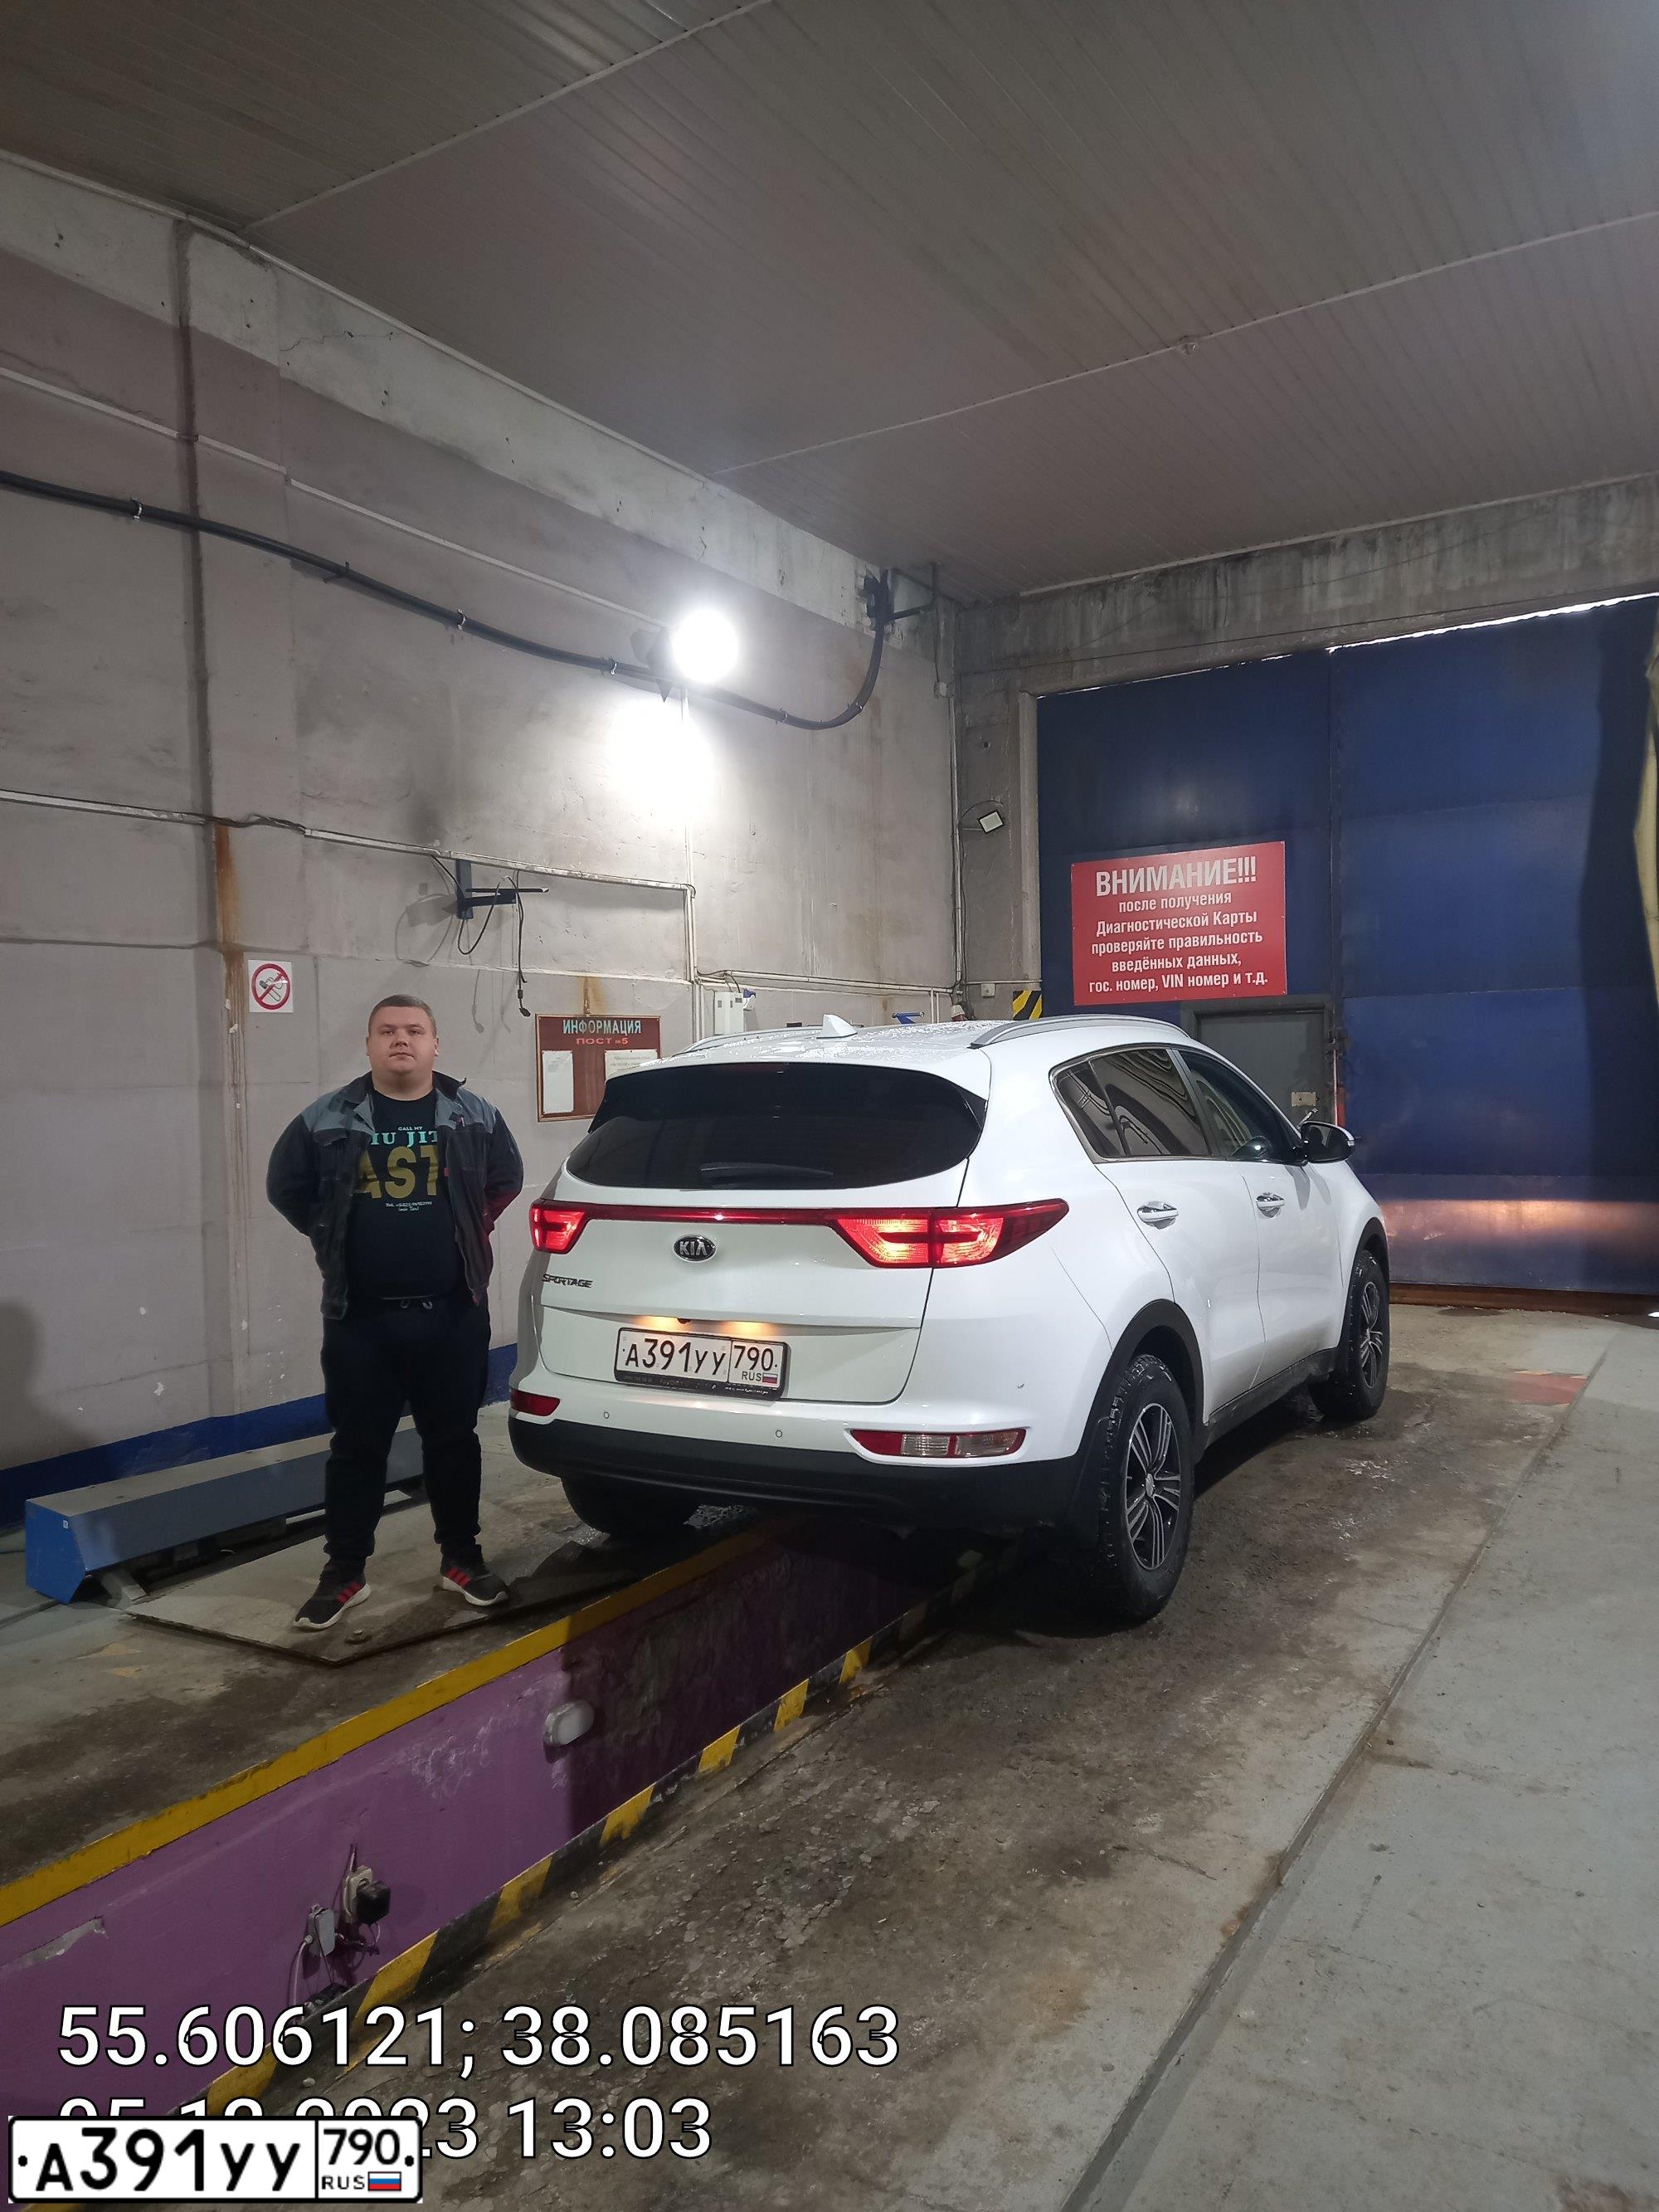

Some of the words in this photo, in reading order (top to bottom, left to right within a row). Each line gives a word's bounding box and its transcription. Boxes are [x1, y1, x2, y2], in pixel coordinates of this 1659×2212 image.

[1096, 856, 1257, 897] ВНИМАНИЕ!!!
[1119, 897, 1156, 913] после
[1160, 891, 1232, 910] получения
[1096, 913, 1209, 937] Диагностической
[1214, 909, 1258, 928] Карты
[1092, 935, 1164, 957] проверяйте
[1169, 931, 1262, 951] правильность
[1112, 954, 1183, 972] введённых
[1187, 952, 1241, 969] данных,
[1089, 980, 1112, 993] гос.
[1117, 977, 1159, 992] номер,
[1161, 973, 1184, 988] VIN
[1188, 970, 1229, 988] номер
[1233, 971, 1241, 985] и
[1245, 969, 1267, 986] т.д.
[563, 1019, 641, 1035] ИНФОРМАЦИЯ
[679, 1240, 708, 1256] KIA
[542, 1273, 593, 1289] SPORTAGE
[733, 1344, 774, 1372] 790
[741, 1371, 761, 1381] RUS
